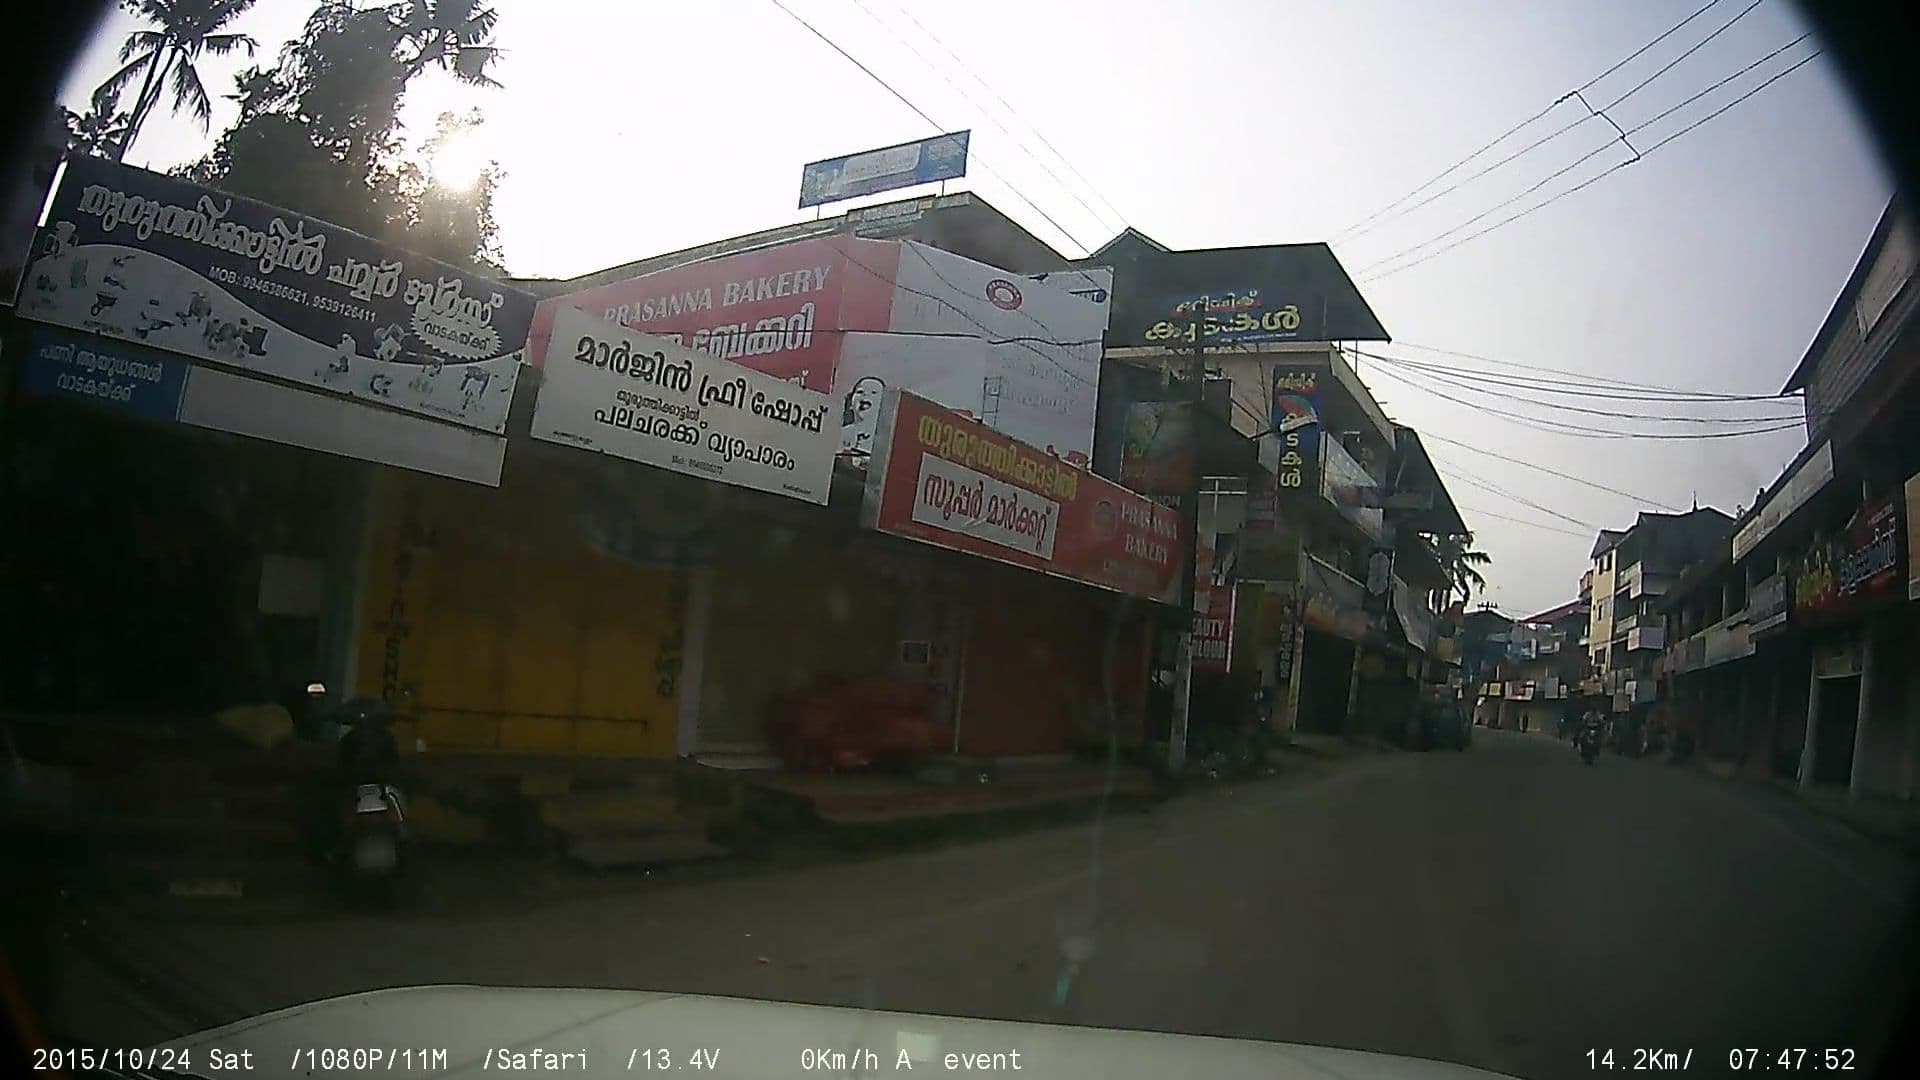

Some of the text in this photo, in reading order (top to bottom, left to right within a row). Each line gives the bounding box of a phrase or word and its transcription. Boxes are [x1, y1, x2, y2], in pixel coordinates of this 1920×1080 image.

[604, 265, 832, 326] PRASANNA BAKERY
[575, 336, 692, 392] മാർജിൻ
[698, 375, 747, 408] ഫ്രീ
[594, 405, 708, 446] പലചരക്ക്
[708, 432, 796, 471] വ്യാപാരം
